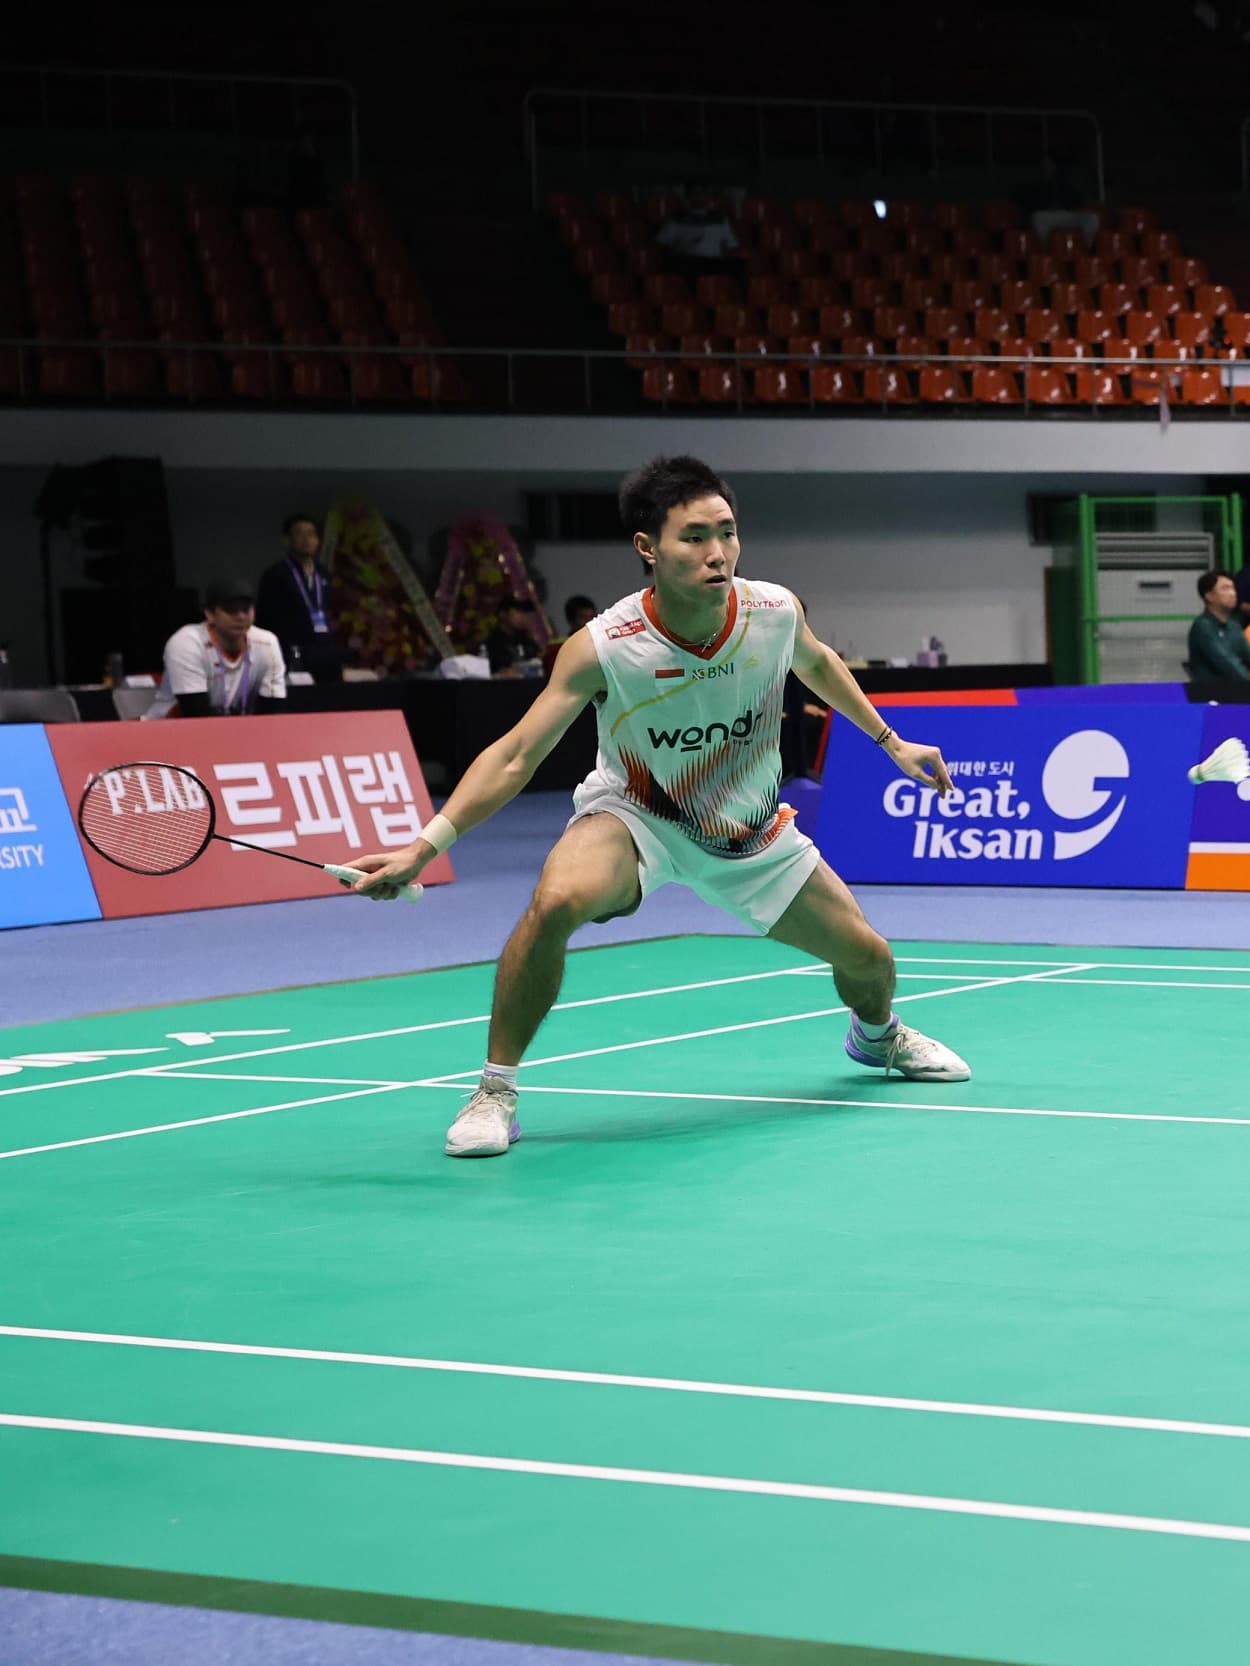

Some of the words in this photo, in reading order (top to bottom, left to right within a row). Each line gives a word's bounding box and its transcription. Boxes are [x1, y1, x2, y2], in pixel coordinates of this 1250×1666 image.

[708, 662, 735, 679] BNI
[988, 760, 1015, 777] 도시
[213, 751, 423, 851] 르피랩
[883, 777, 1031, 820] Great,
[912, 820, 1044, 860] Iksan
